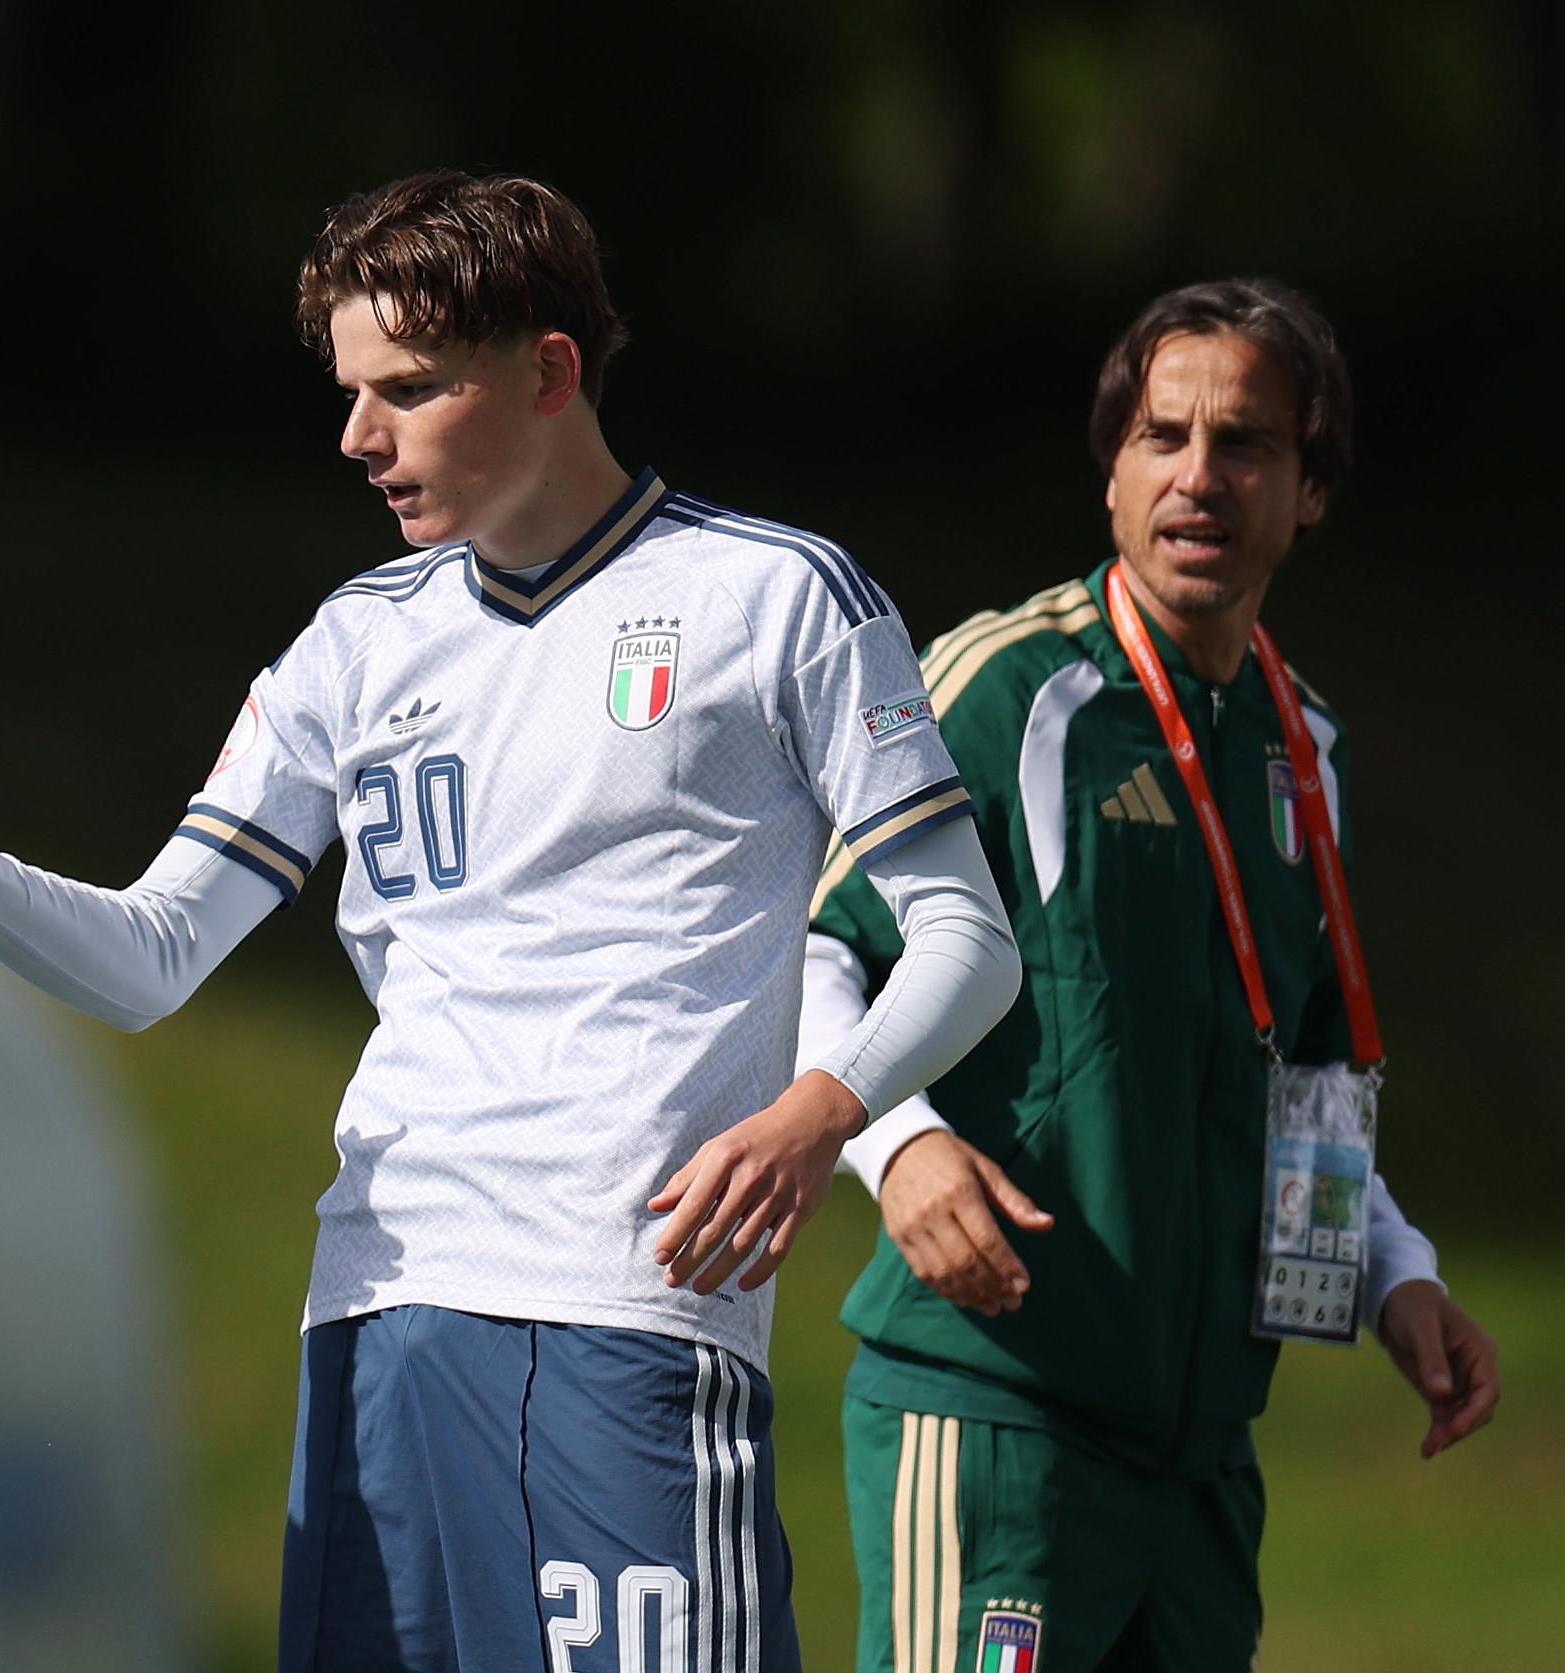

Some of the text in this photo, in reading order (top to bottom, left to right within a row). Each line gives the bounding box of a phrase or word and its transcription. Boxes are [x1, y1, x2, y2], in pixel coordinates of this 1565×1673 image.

[618, 639, 673, 660] ITALIA
[863, 704, 886, 721] UEFA
[355, 753, 469, 903] 20
[1318, 1273, 1331, 1291] 2
[1314, 1304, 1326, 1323] 6
[539, 1559, 690, 1673] 20
[987, 1620, 1034, 1642] ITALIA
